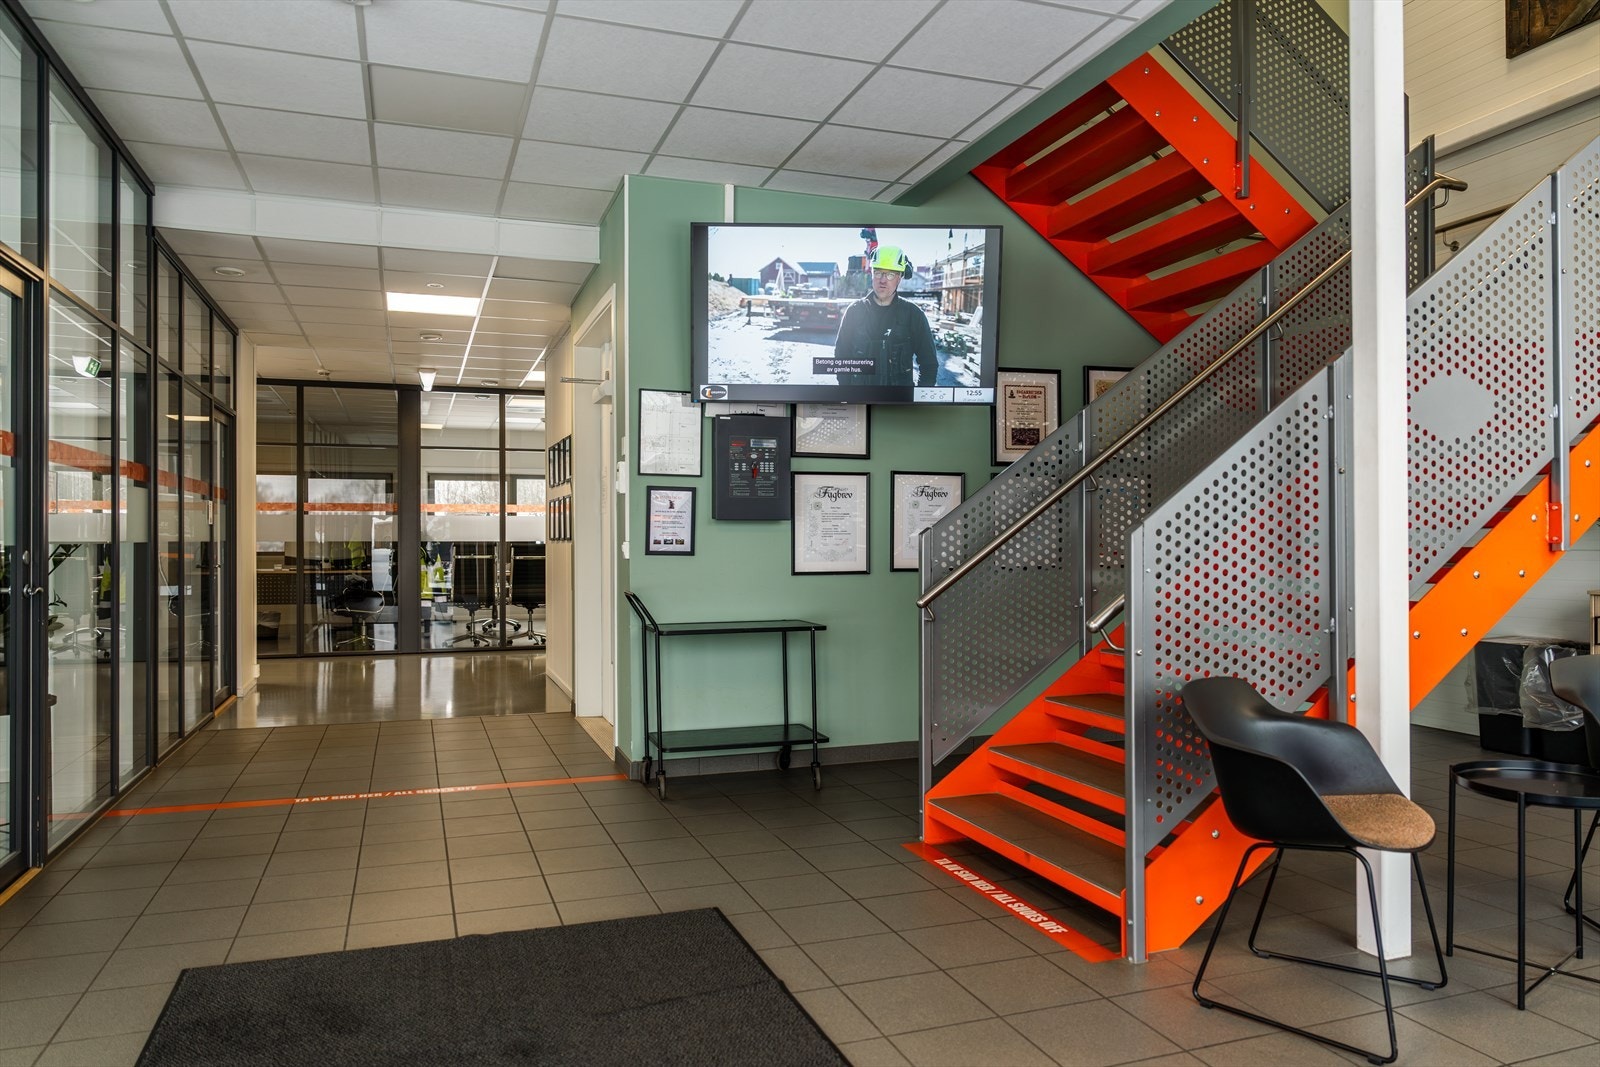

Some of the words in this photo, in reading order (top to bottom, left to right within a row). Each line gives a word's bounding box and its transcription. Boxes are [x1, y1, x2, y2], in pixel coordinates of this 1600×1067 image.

[966, 389, 983, 397] 12:55
[953, 869, 980, 881] SKO
[969, 879, 996, 891] HER
[990, 893, 1017, 904] ALL
[1007, 902, 1049, 923] SHOES
[1038, 921, 1069, 933] OFF
